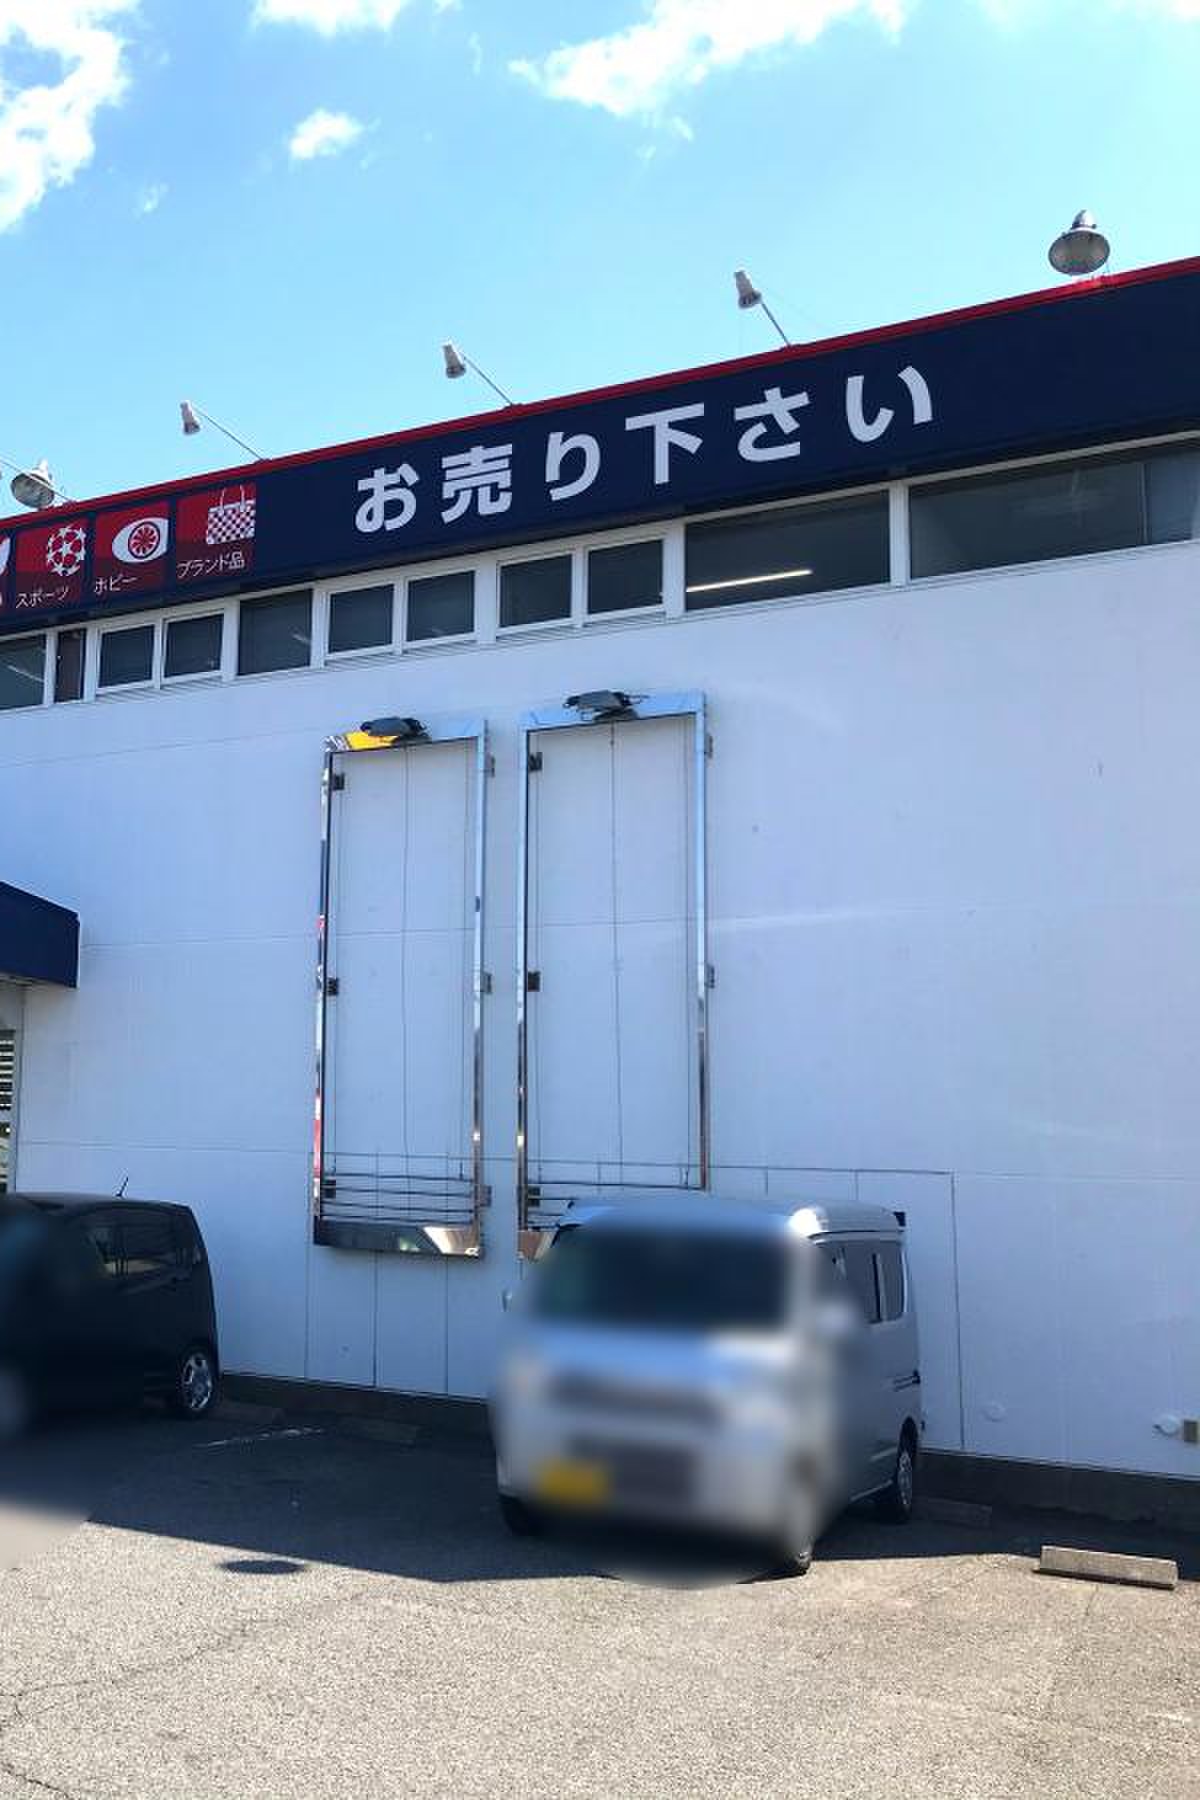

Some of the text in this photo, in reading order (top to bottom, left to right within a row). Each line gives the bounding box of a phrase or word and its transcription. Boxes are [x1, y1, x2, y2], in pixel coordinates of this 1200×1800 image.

[354, 365, 933, 533] お売り下さい
[93, 574, 138, 594] ホビー
[15, 585, 70, 609] スポーツ
